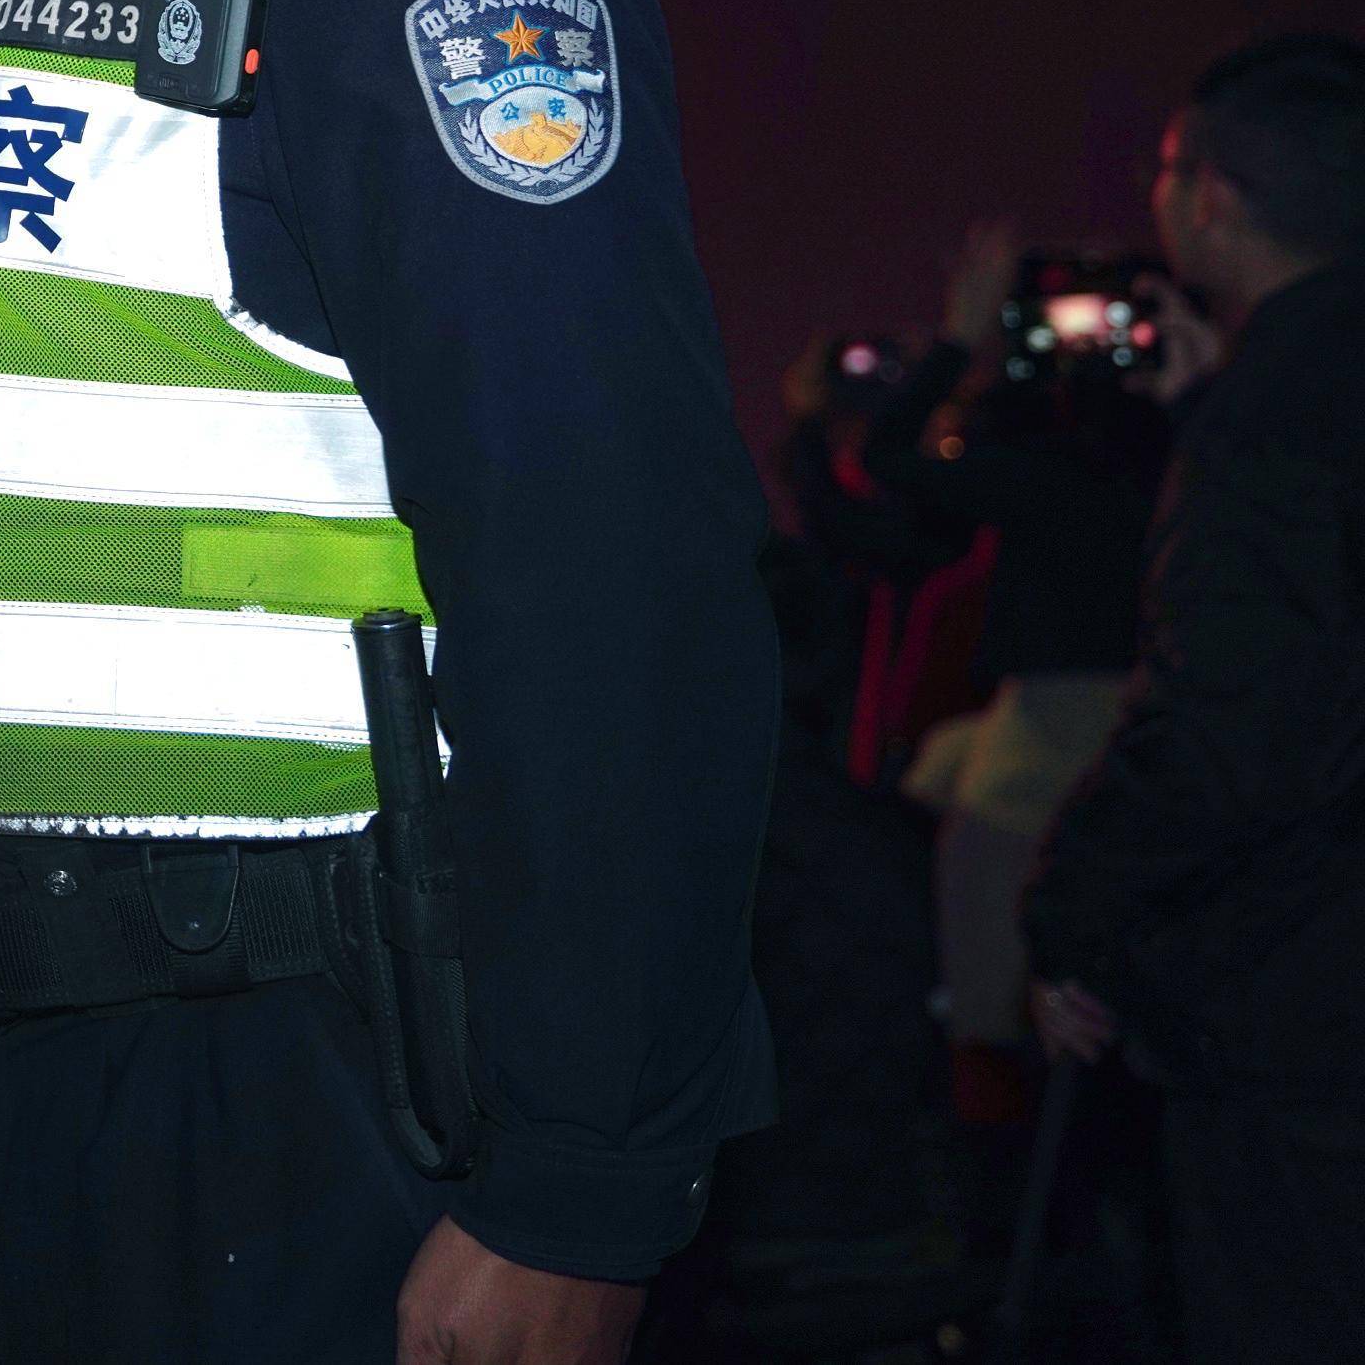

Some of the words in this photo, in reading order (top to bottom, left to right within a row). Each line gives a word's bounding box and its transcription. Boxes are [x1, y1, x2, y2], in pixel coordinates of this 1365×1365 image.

[439, 36, 486, 80] 警
[555, 28, 595, 67] 察
[487, 66, 569, 96] POLICE
[501, 102, 519, 121] 公
[548, 97, 567, 119] 安
